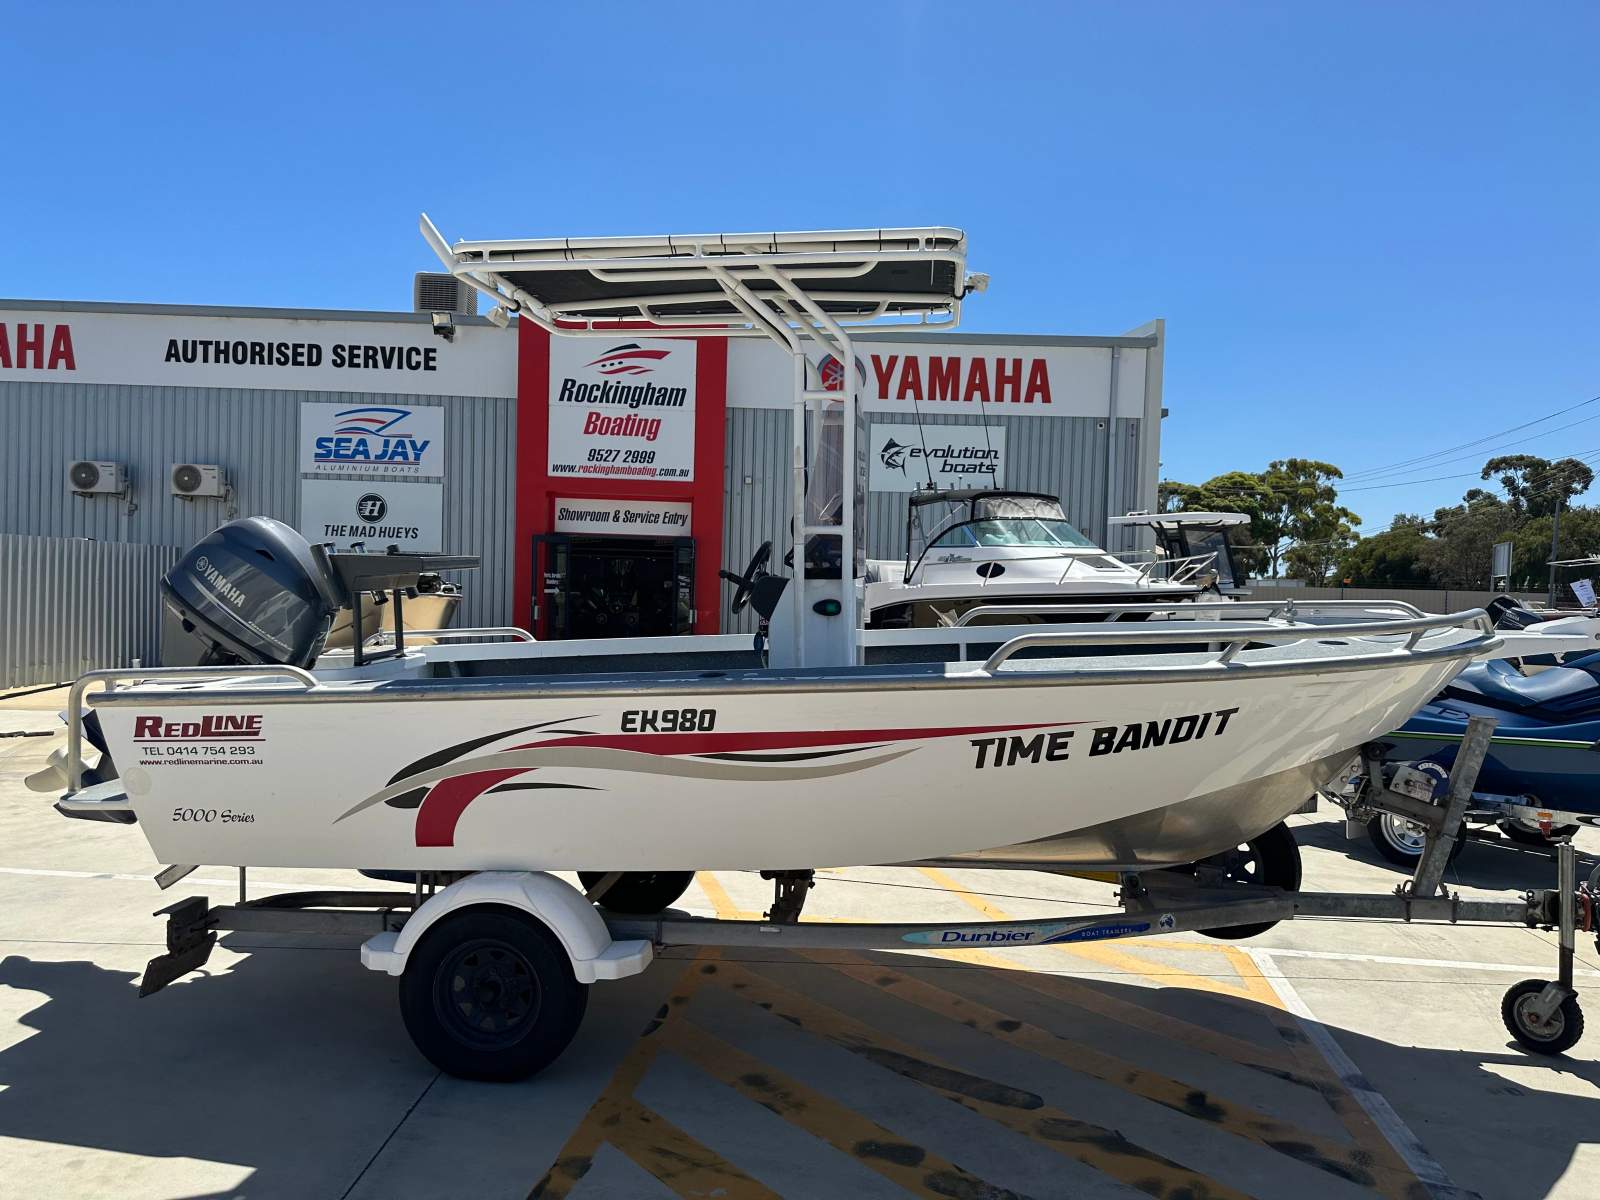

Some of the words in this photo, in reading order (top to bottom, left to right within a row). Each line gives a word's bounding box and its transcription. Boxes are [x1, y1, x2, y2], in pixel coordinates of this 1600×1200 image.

[165, 339, 322, 367] AUTHORISED
[332, 344, 437, 371] SERVICE
[870, 354, 1052, 404] YAMAHA
[559, 378, 687, 409] Rockingham
[583, 411, 662, 442] Boating
[314, 436, 371, 460] SEA
[374, 438, 431, 462] JAY
[587, 448, 620, 463] 9527
[623, 450, 656, 464] 2999
[909, 444, 999, 459] evolution
[315, 464, 379, 472] ALUMINIUM
[552, 463, 689, 478] www.rockinghamboating.com.au
[939, 459, 998, 474] boats
[558, 507, 611, 522] Showroom
[612, 509, 621, 523] &
[622, 510, 660, 524] Service
[662, 511, 688, 527] Entry
[324, 524, 347, 537] THE
[348, 526, 377, 538] MAD
[378, 526, 419, 539] HUEYS
[204, 564, 246, 608] YAMAHA
[620, 708, 717, 733] EK980
[968, 730, 1075, 769] TIME
[1088, 707, 1240, 757] BANDIT
[142, 746, 164, 756] TEL
[166, 746, 198, 756] 0414
[202, 746, 226, 755] 754
[230, 746, 256, 755] 293
[139, 758, 263, 766] www.redlinemarine.com.au
[172, 807, 217, 823] 5000
[220, 809, 256, 823] Series
[941, 930, 1035, 943] Dunbier
